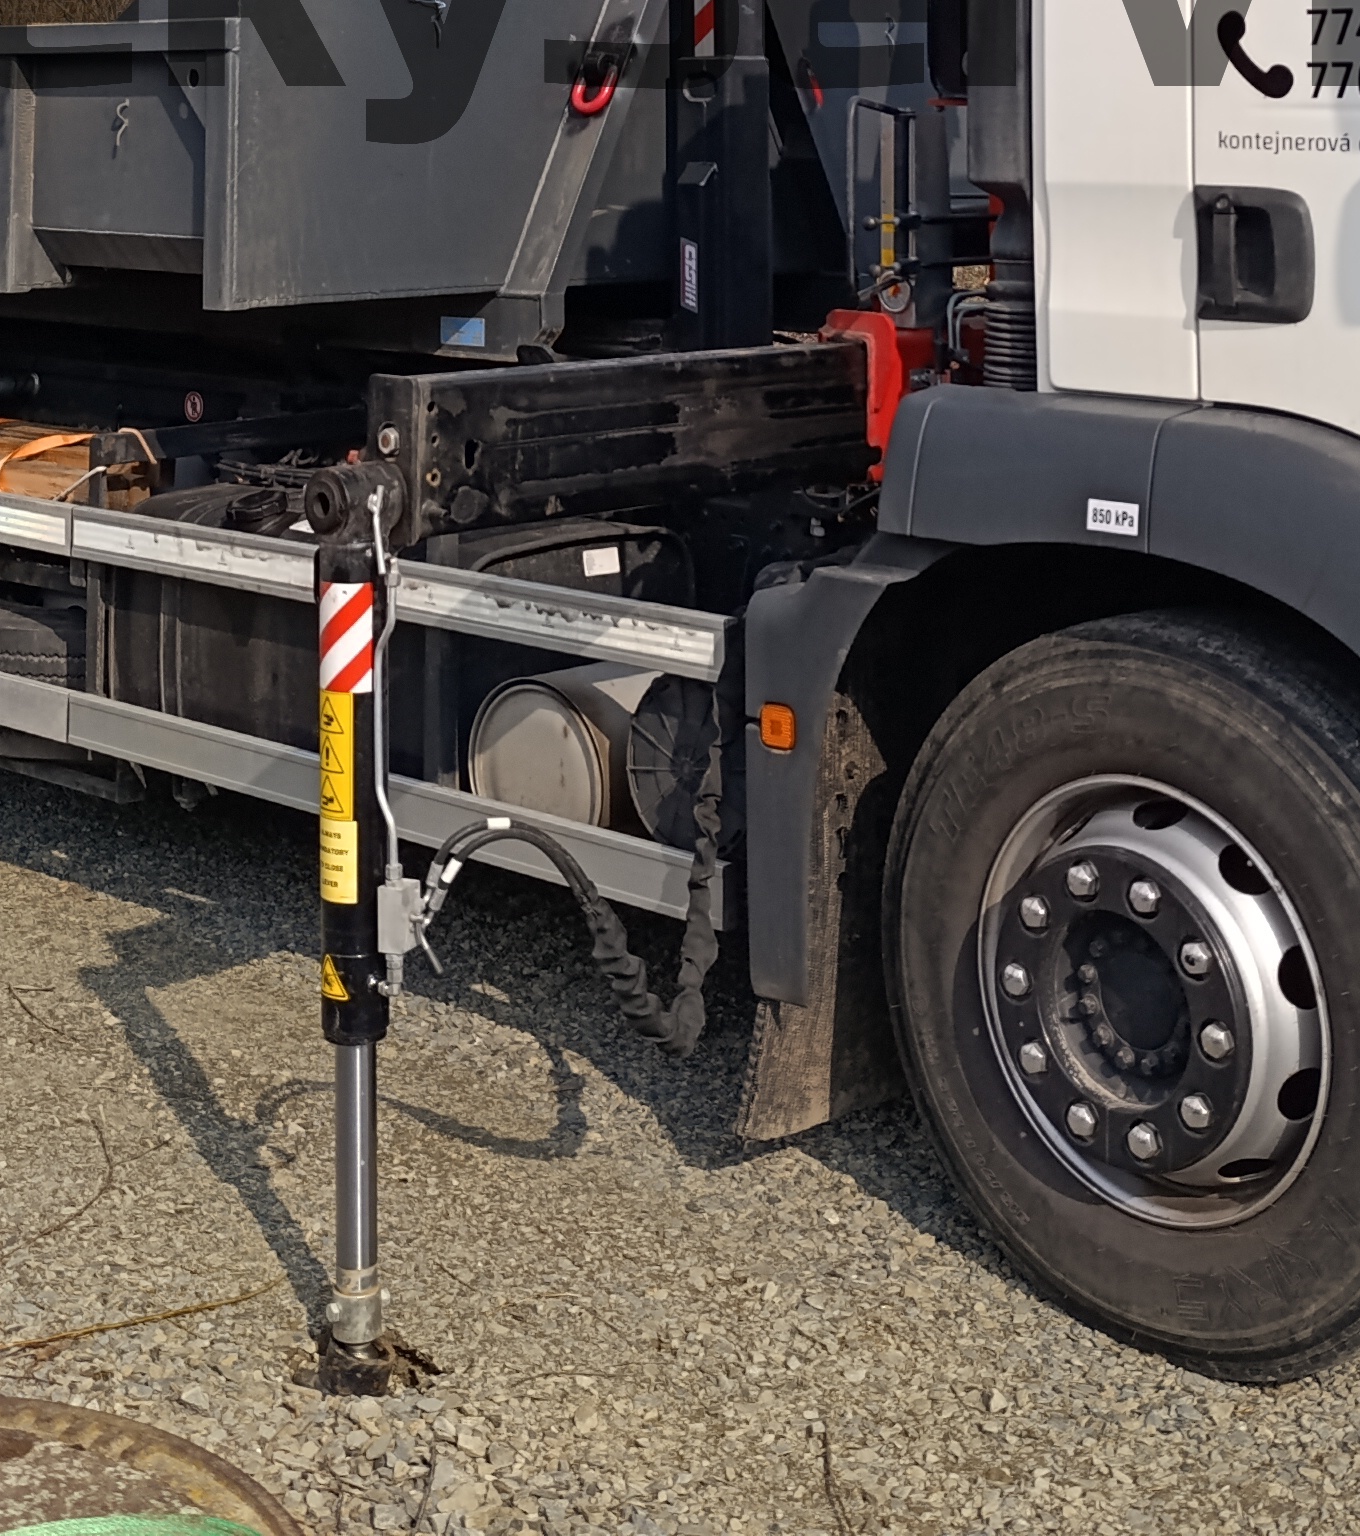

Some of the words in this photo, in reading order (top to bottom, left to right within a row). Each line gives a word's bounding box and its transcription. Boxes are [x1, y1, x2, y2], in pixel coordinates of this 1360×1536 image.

[1218, 131, 1351, 155] kontejnerová
[1091, 507, 1112, 525] 850
[1115, 509, 1134, 528] kPa
